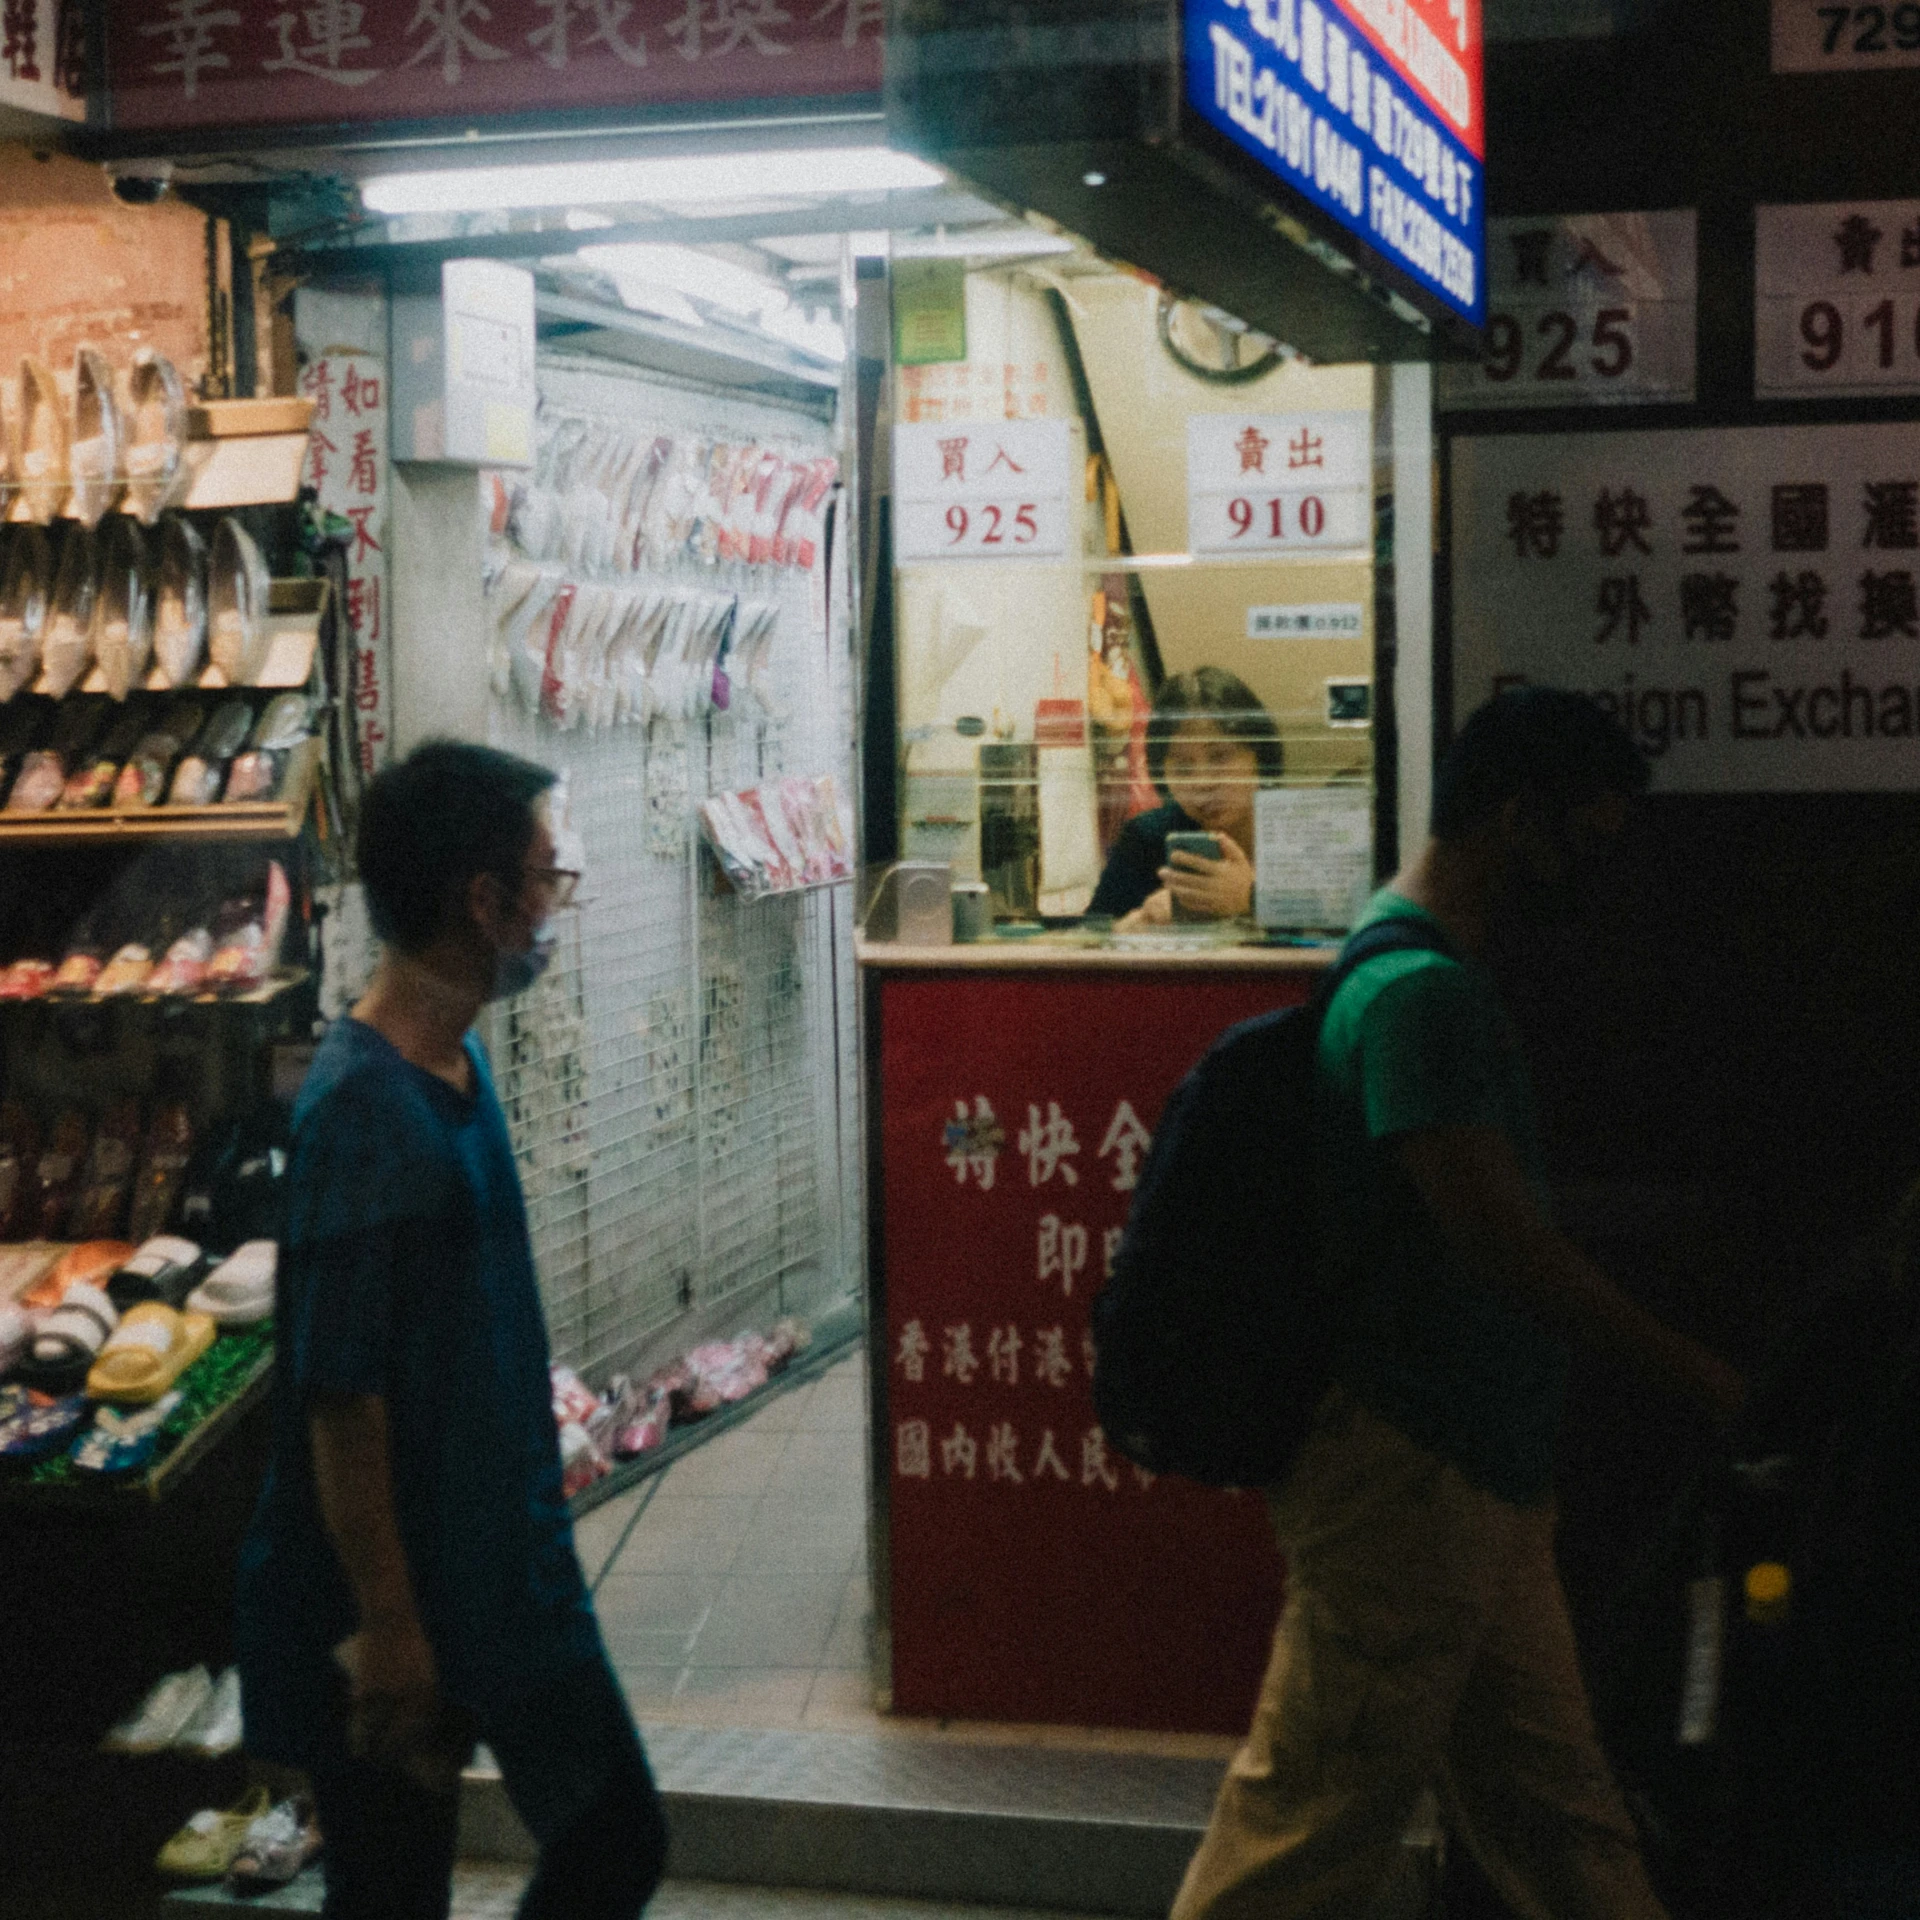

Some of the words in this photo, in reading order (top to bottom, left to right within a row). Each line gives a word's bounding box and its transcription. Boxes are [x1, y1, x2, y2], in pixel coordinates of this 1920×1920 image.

[1817, 7, 1920, 54] 729
[1484, 309, 1632, 382] 925
[1801, 300, 1920, 372] 91
[936, 436, 1025, 482] 買入
[1234, 424, 1324, 476] 賣出
[945, 503, 1038, 546] 925
[1226, 495, 1325, 540] 910
[1732, 669, 1920, 739] Excha
[897, 1420, 1157, 1492] 國內收人民
